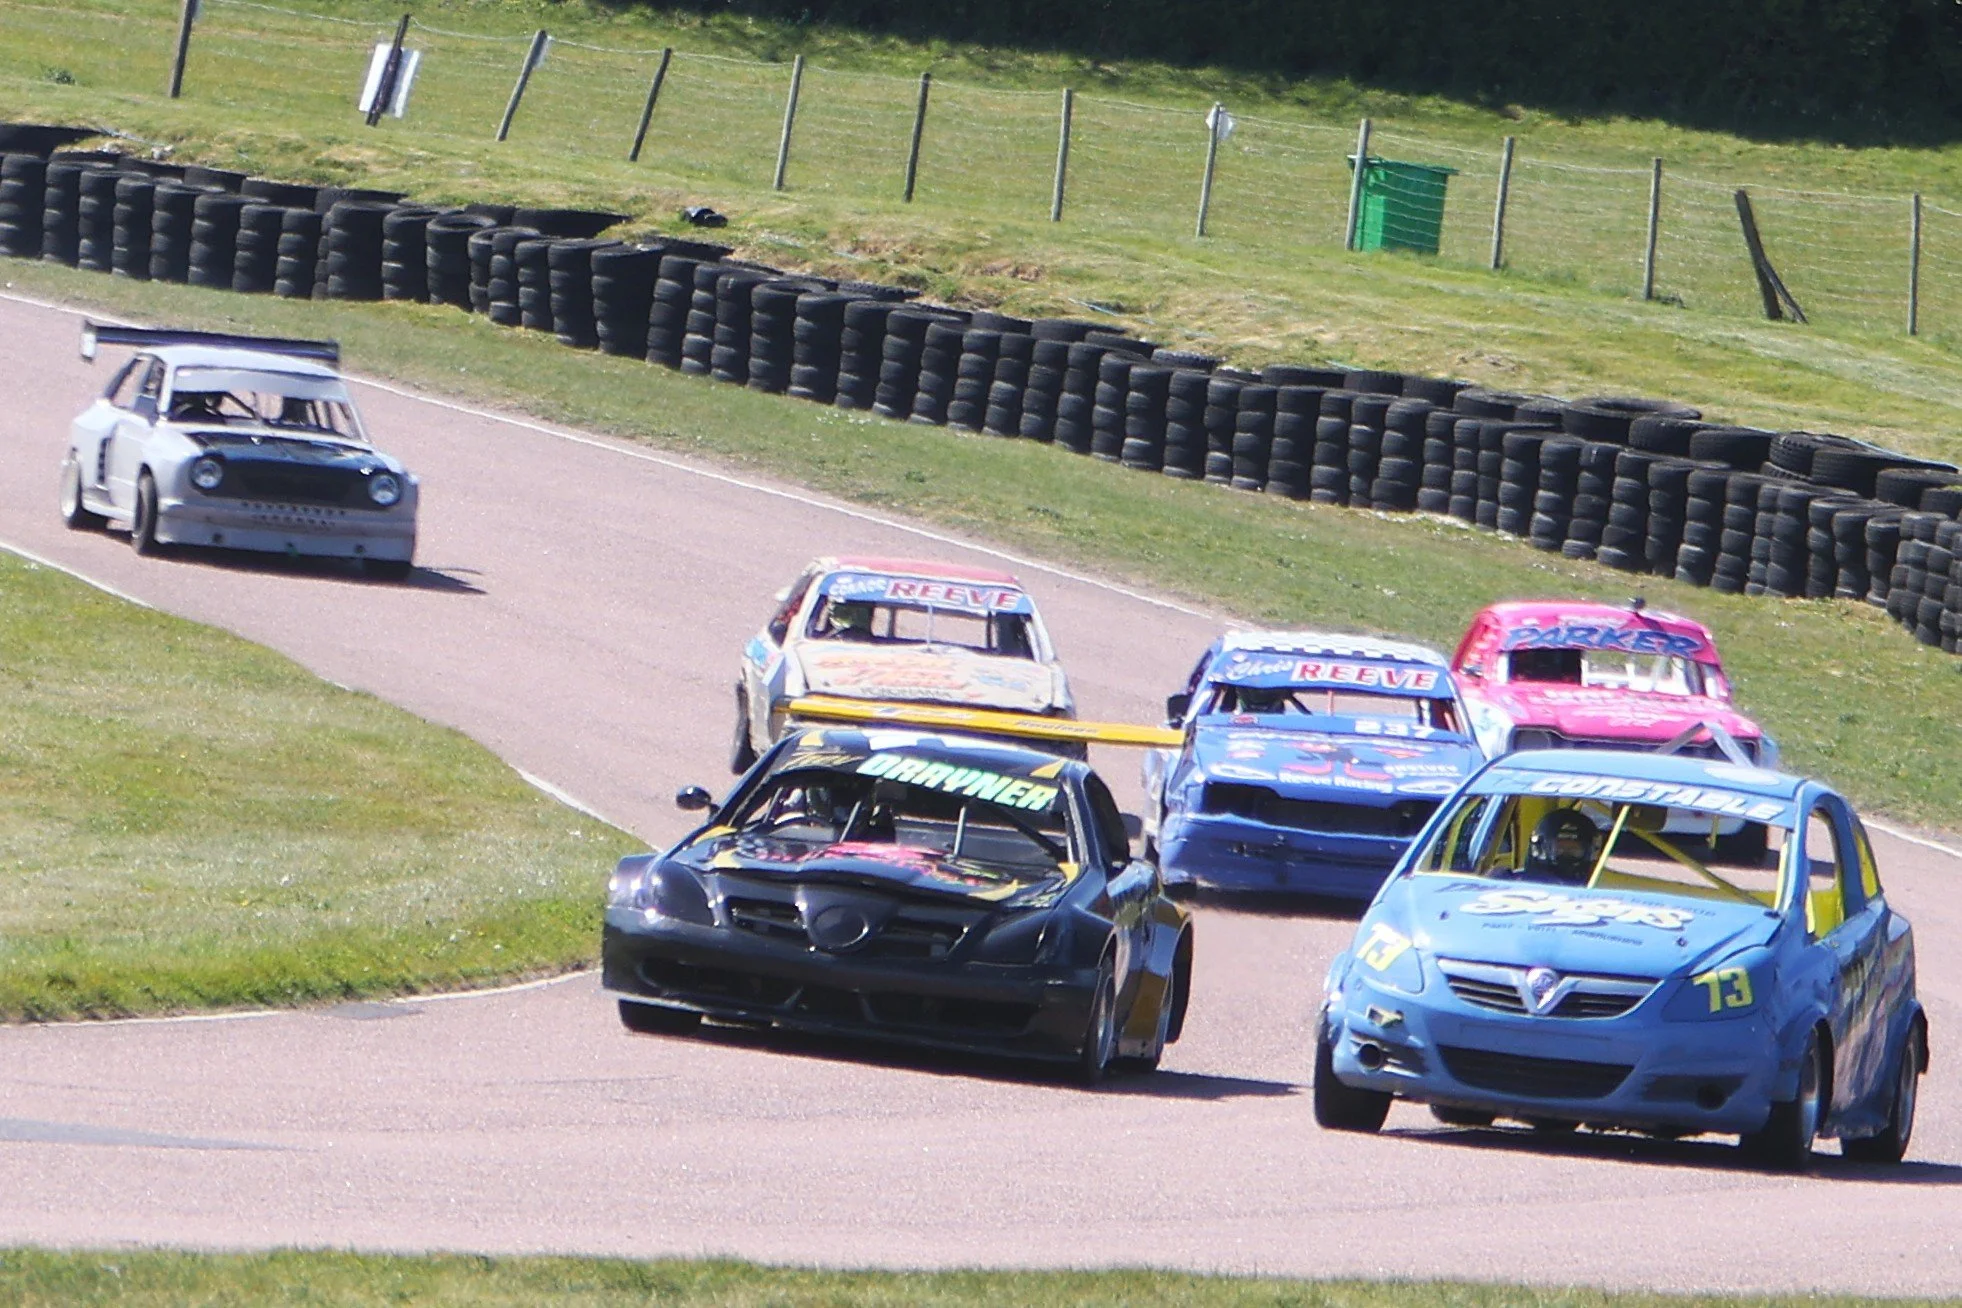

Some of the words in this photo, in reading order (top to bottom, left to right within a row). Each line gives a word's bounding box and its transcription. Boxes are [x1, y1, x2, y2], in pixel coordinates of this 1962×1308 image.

[887, 580, 1019, 609] REEVE
[1505, 626, 1701, 657] PARKER
[1293, 661, 1438, 690] REEVE
[856, 753, 1058, 810] DRAYNER
[1531, 776, 1785, 820] CONSTABLE
